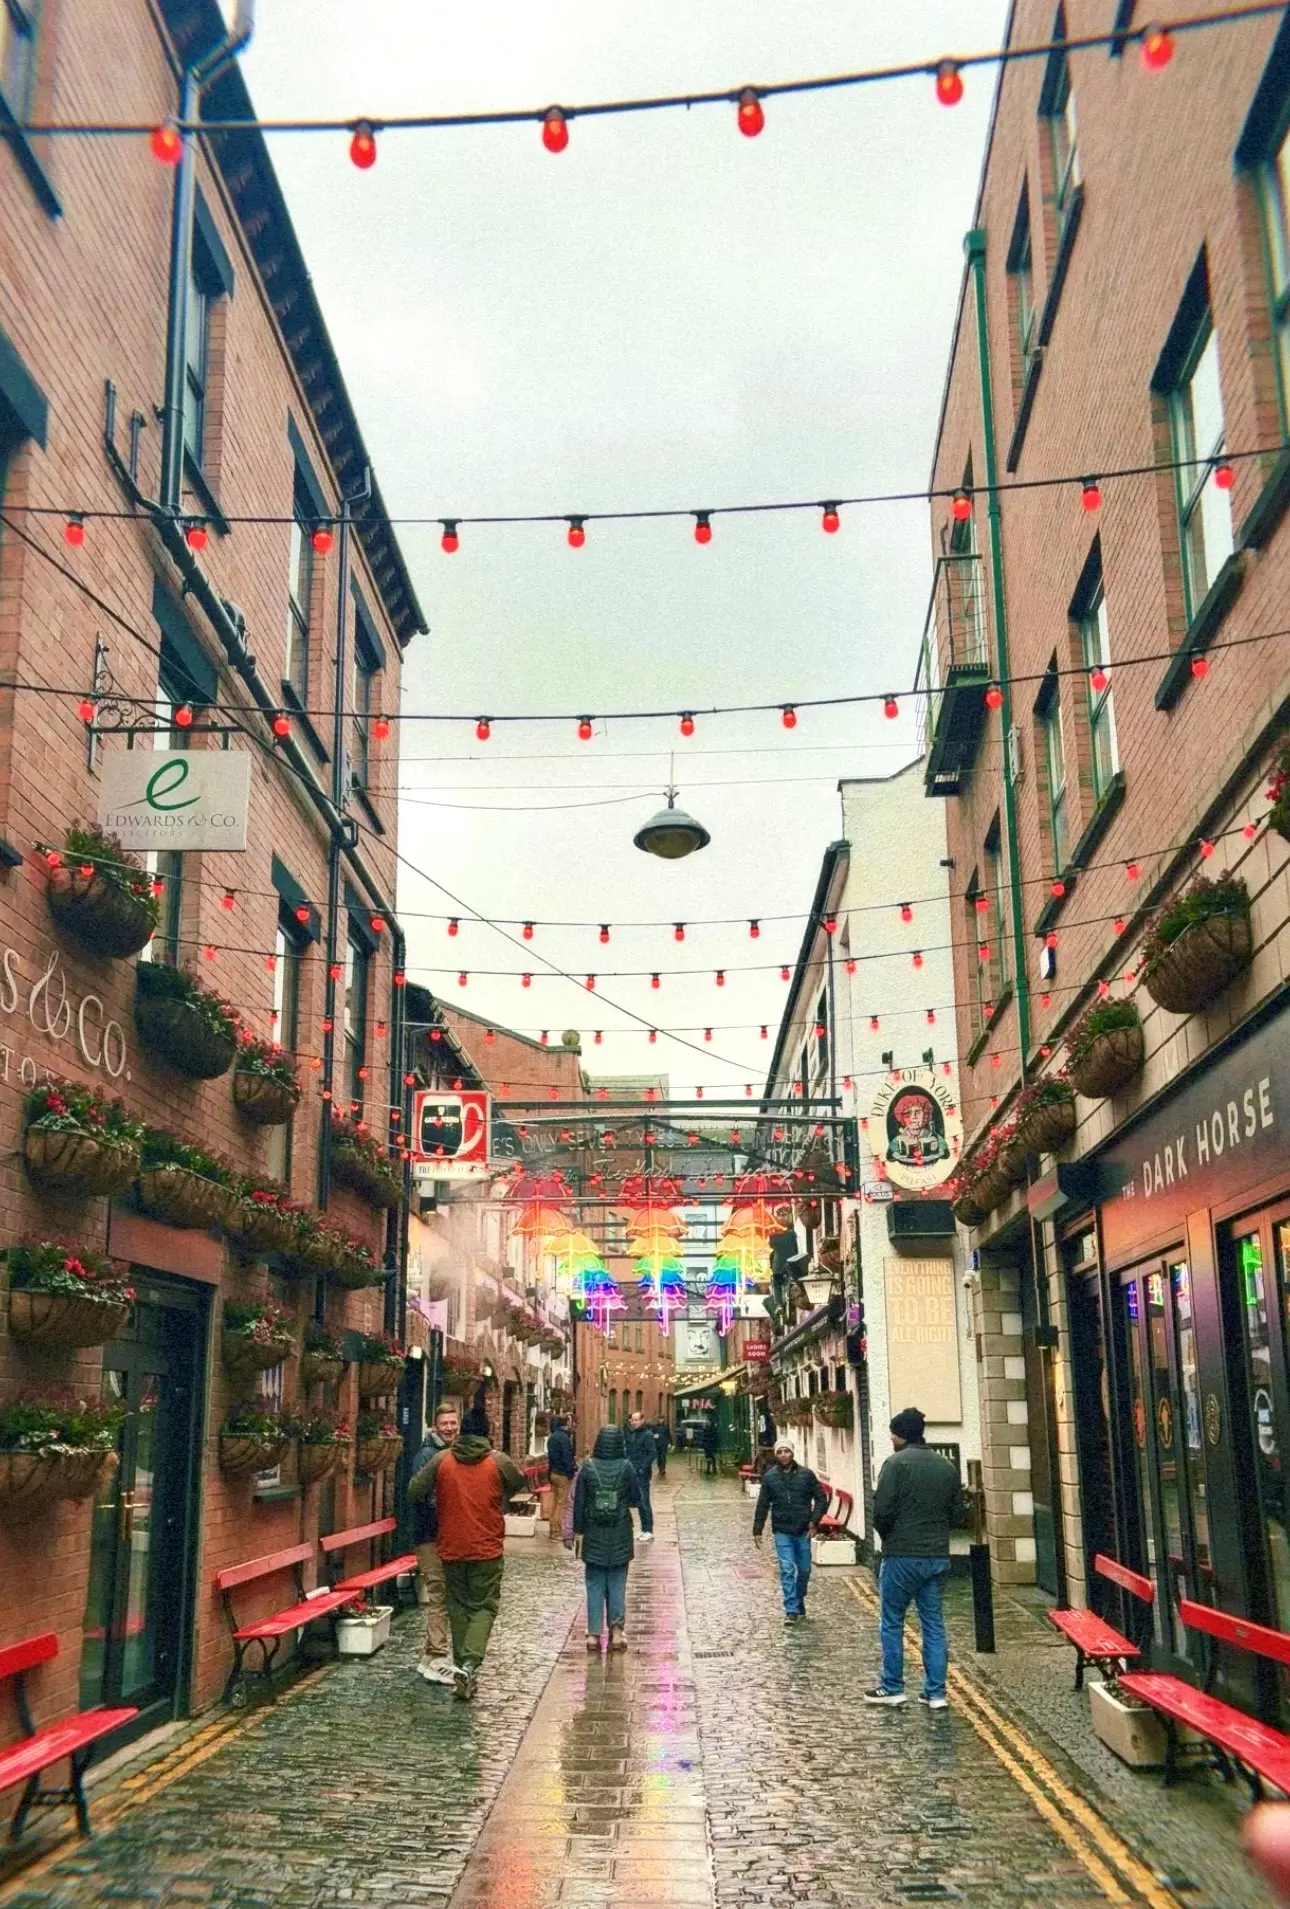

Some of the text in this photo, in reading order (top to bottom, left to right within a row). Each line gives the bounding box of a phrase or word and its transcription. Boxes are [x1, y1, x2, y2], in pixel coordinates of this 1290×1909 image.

[105, 814, 184, 827] EDWARDS
[188, 813, 207, 826] &
[902, 1069, 922, 1083] OF
[1121, 1076, 1274, 1201] THE DARK HORSE
[887, 1260, 951, 1275] EVERYTHING
[887, 1276, 952, 1295] IS GOING
[888, 1296, 954, 1325] TO BE
[891, 1326, 954, 1343] ALL RIGHT
